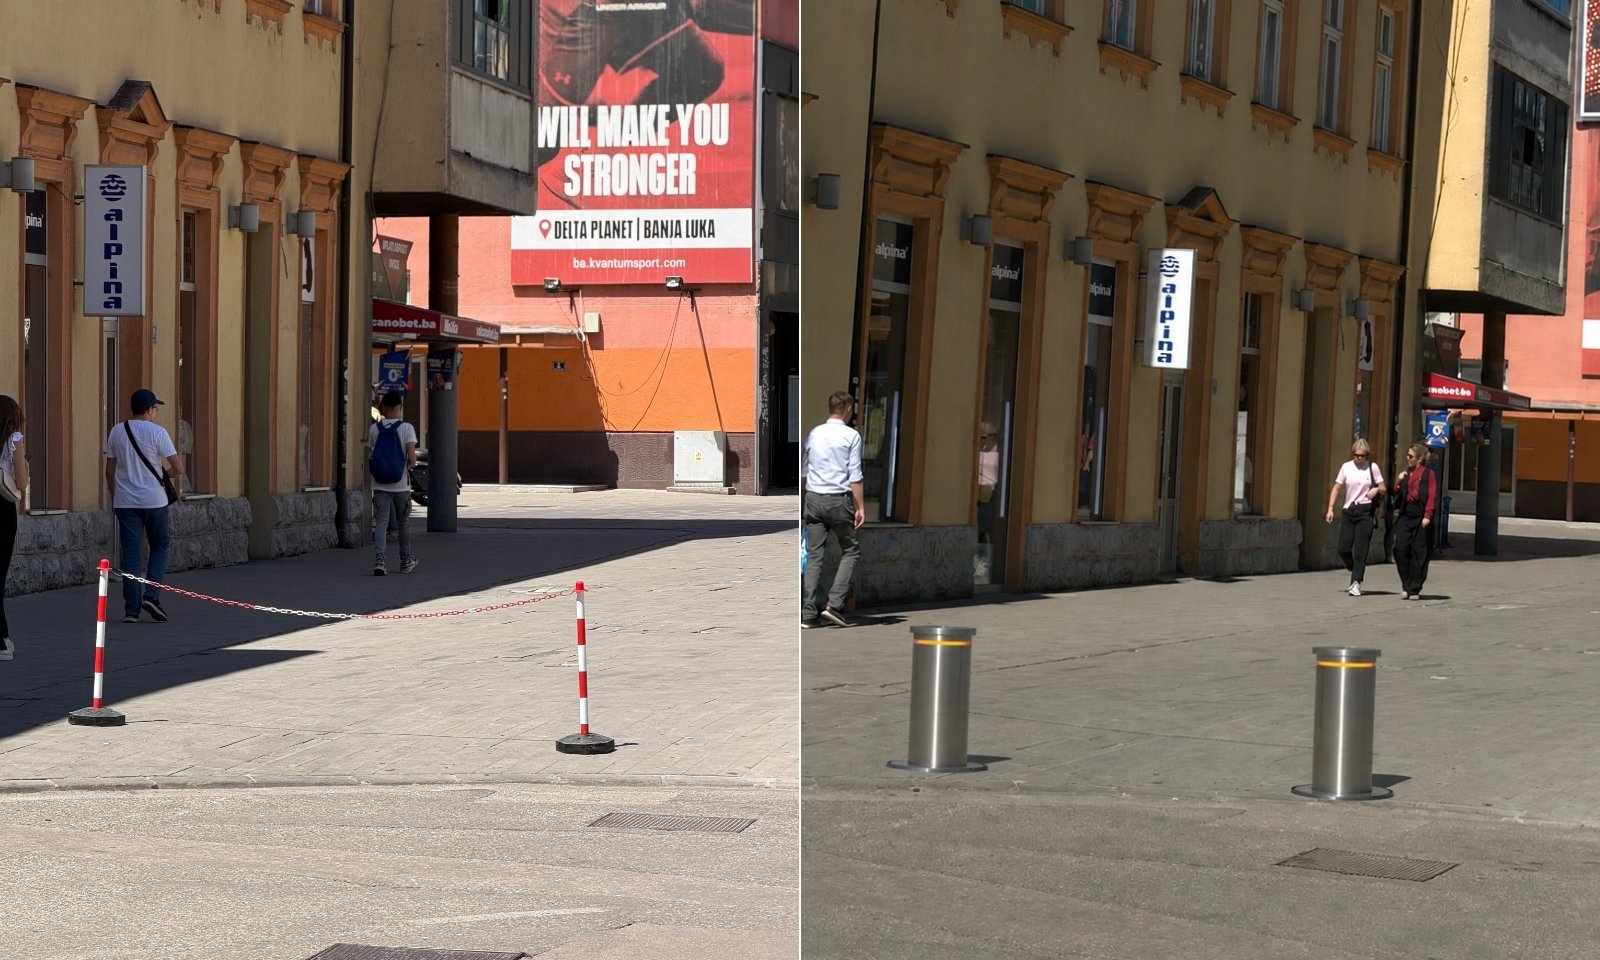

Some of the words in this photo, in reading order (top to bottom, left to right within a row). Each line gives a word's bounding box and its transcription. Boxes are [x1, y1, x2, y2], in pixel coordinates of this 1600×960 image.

[537, 106, 591, 148] WILL
[597, 104, 670, 148] MAKE
[675, 103, 729, 146] YOU
[564, 153, 697, 196] STRONGER
[554, 220, 588, 239] DELTA
[591, 220, 633, 239] PLANET
[643, 219, 682, 239] BANJA
[685, 219, 716, 238] LUKA
[103, 208, 123, 309] alpina
[573, 256, 686, 270] ba.kvantumsport.com
[1157, 283, 1176, 363] alpina
